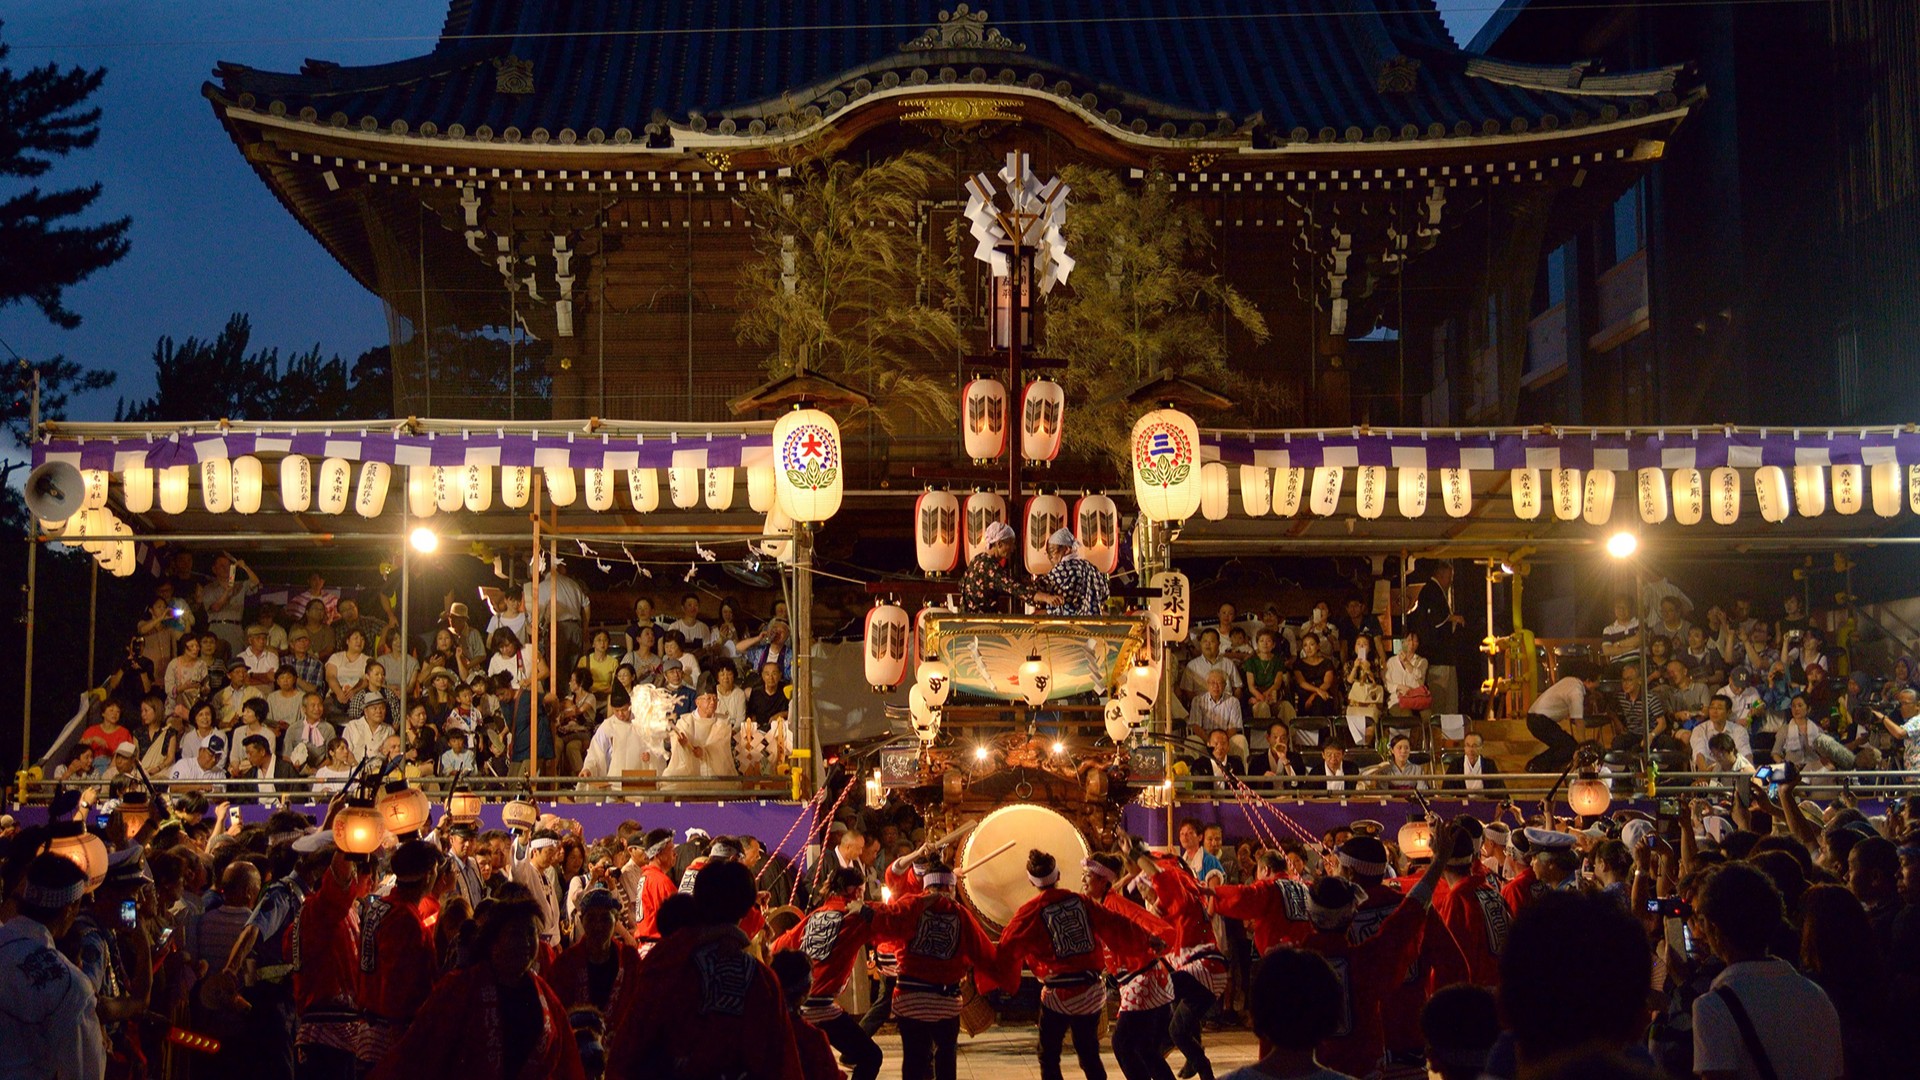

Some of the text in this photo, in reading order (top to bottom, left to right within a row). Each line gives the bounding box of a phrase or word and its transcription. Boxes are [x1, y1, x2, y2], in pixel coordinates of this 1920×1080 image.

[801, 433, 822, 457] 大
[1150, 433, 1175, 456] 三
[1689, 472, 1701, 515] 石取祭
[1163, 577, 1185, 633] 清水町
